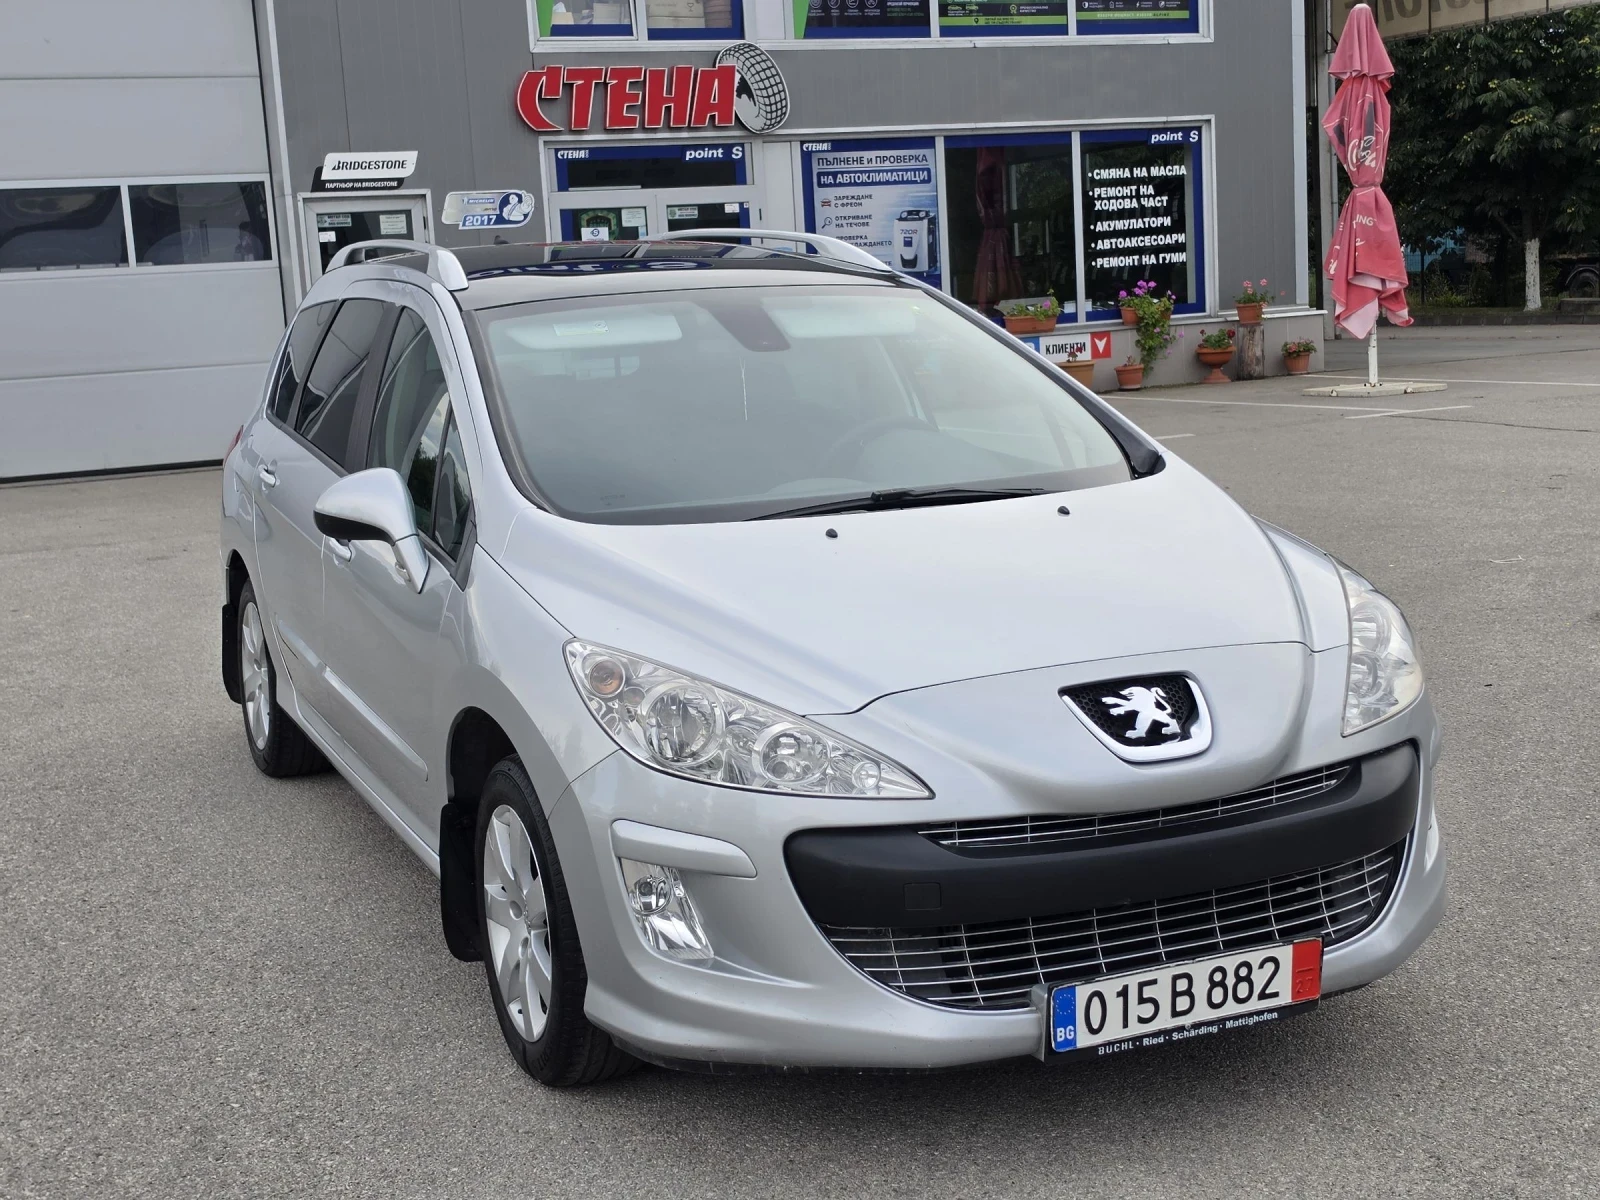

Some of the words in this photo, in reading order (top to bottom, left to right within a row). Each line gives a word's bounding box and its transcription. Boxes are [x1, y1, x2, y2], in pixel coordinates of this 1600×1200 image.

[517, 64, 737, 131] СТЕНА
[1151, 131, 1183, 144] point
[1189, 130, 1199, 142] S
[685, 147, 723, 160] point
[731, 146, 743, 159] S
[803, 143, 827, 152] СТЕНА
[557, 150, 585, 160] СТЕНА
[817, 155, 865, 167] ПЪЛНЕНЕ
[875, 154, 928, 165] ПРОВЕРКА
[331, 160, 408, 171] BRIDGESTONE
[1093, 168, 1131, 179] СМЯНА
[1133, 167, 1148, 177] НА
[1150, 165, 1187, 176] МАСЛА
[820, 175, 835, 184] НА
[836, 171, 928, 183] АВТОКЛИМАТИЦИ
[325, 181, 354, 189] ПАРТНЬОР
[1094, 186, 1137, 198] РЕМОНТ
[1140, 185, 1155, 195] НА
[1094, 199, 1139, 211] ХОДОВА
[1141, 196, 1168, 208] ЧАСТ
[465, 215, 497, 226] 2017
[1095, 216, 1171, 232] АКУМУЛАТОРИ
[1096, 233, 1186, 250] АВТОАКСЕСОАРИ
[1096, 256, 1140, 269] РЕМОНТ
[1142, 254, 1157, 265] НА
[1159, 252, 1187, 264] ГУМИ
[1045, 341, 1086, 355] КЛИЕНТИ
[1084, 978, 1160, 1036] 015
[1171, 972, 1195, 1019] B
[1206, 955, 1281, 1010] 882
[1057, 1025, 1075, 1042] BG
[1143, 1034, 1164, 1047] Ried
[1172, 1023, 1218, 1041] Schärding
[1225, 1010, 1278, 1029] Mattighofen
